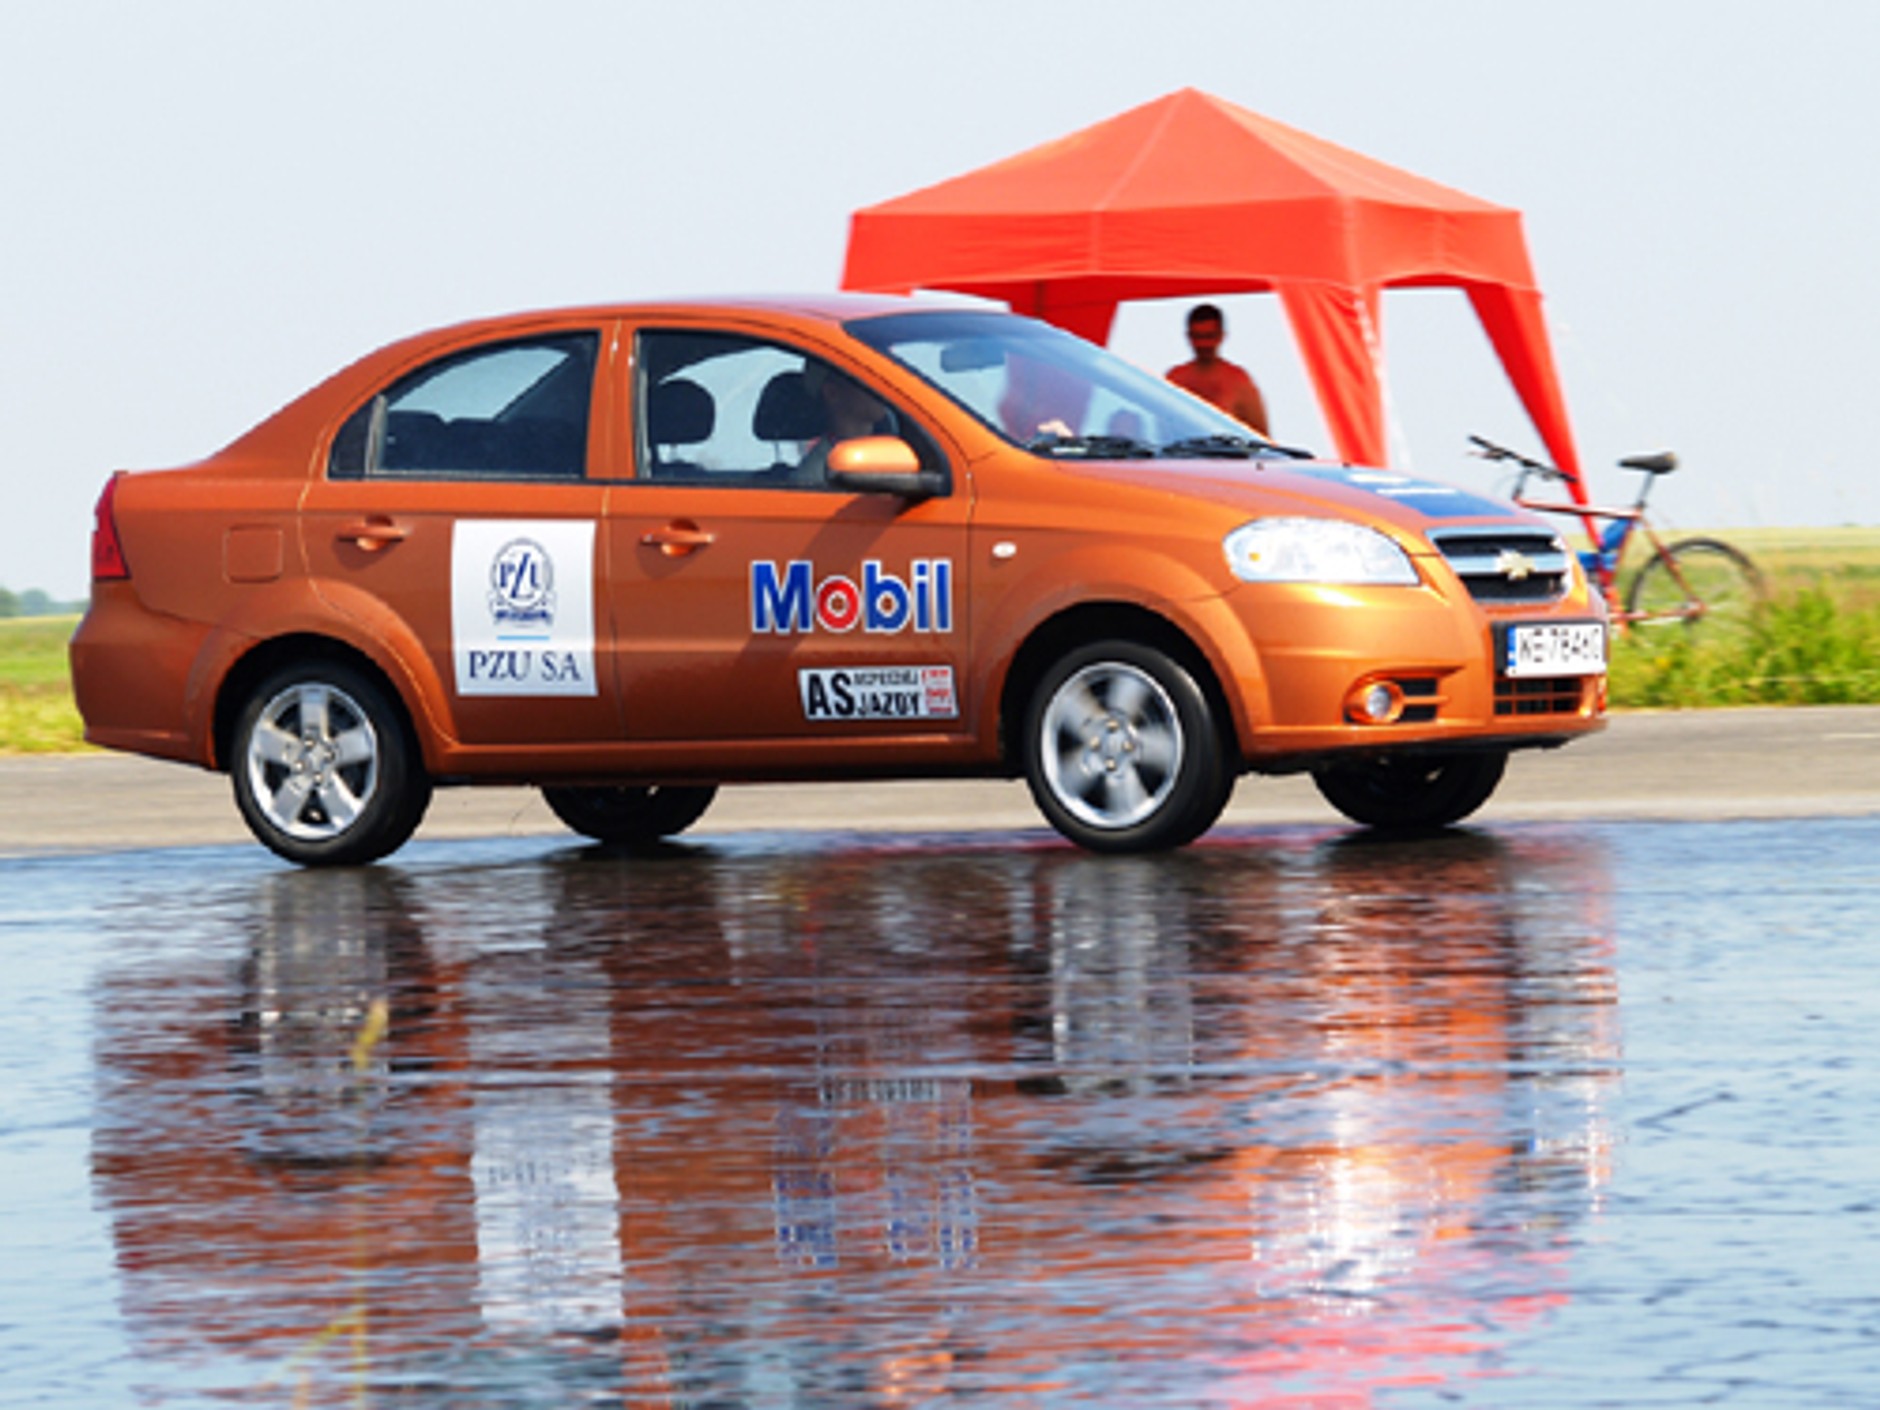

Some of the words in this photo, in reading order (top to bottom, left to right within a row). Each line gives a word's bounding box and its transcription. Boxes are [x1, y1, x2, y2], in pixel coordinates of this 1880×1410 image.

[750, 560, 953, 635] Mobil
[468, 650, 532, 682] PZU
[541, 650, 582, 682] SA
[808, 672, 855, 716] AS
[856, 691, 920, 716] JAZDY
